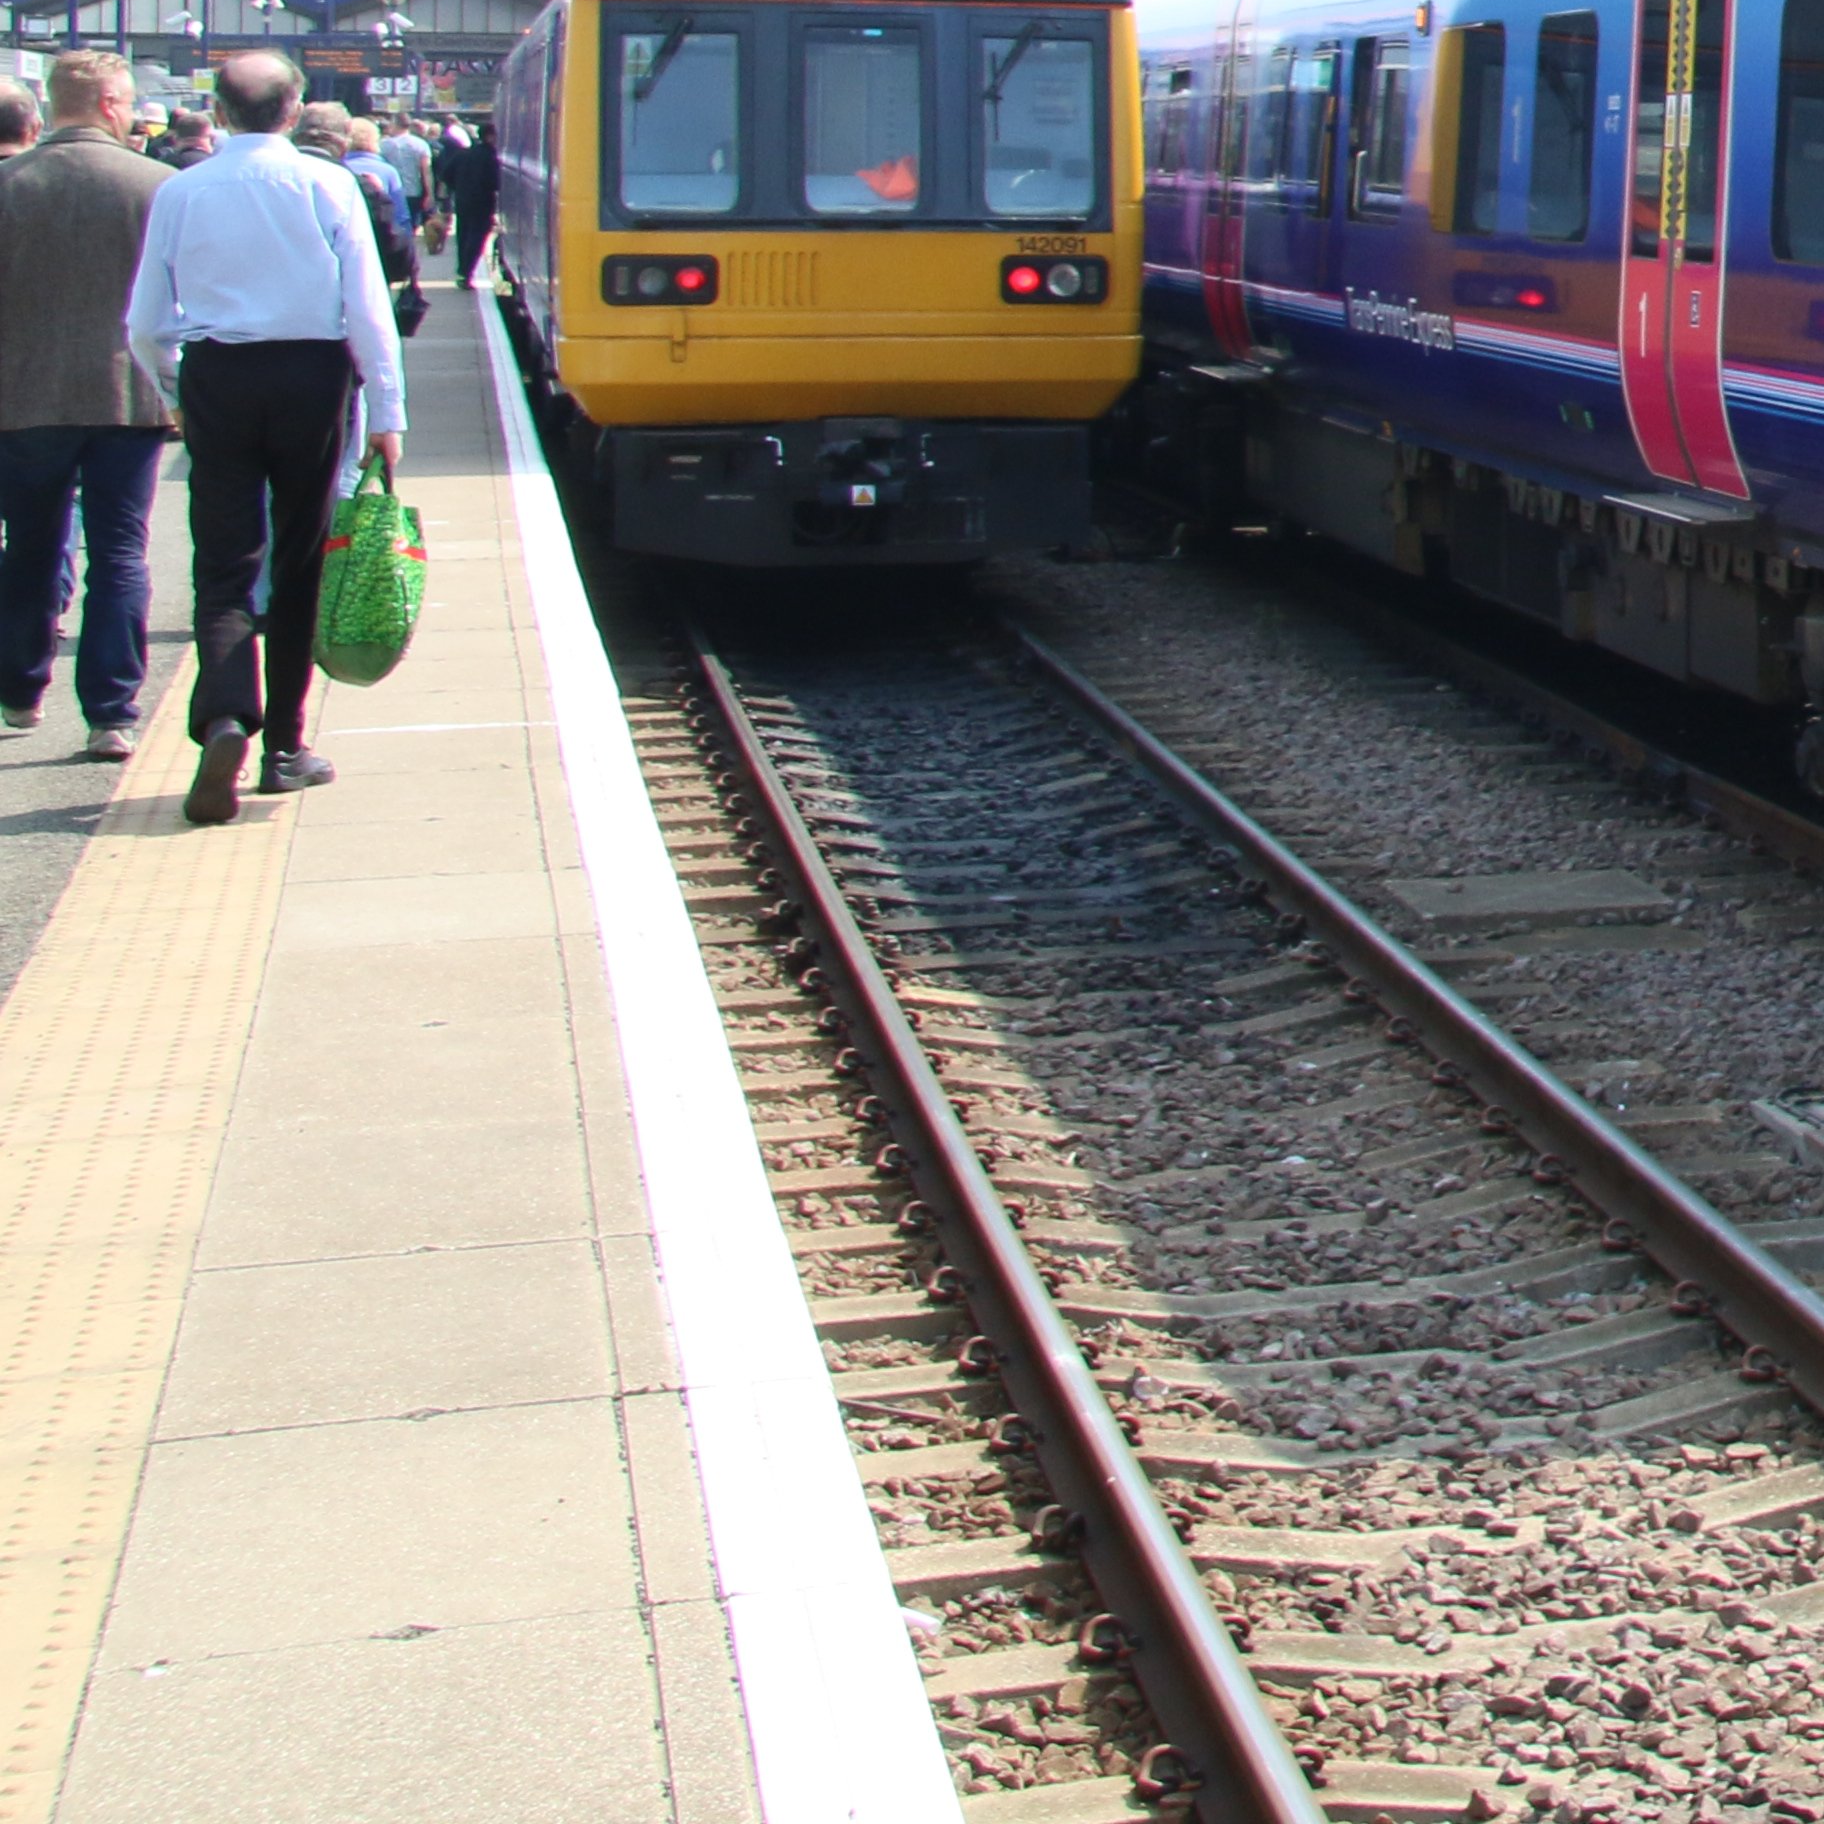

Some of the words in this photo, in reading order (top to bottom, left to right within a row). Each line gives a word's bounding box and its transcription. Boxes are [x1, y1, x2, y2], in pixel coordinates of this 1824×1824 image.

[375, 78, 387, 91] 3
[400, 78, 412, 91] 2
[1016, 236, 1087, 254] 142091
